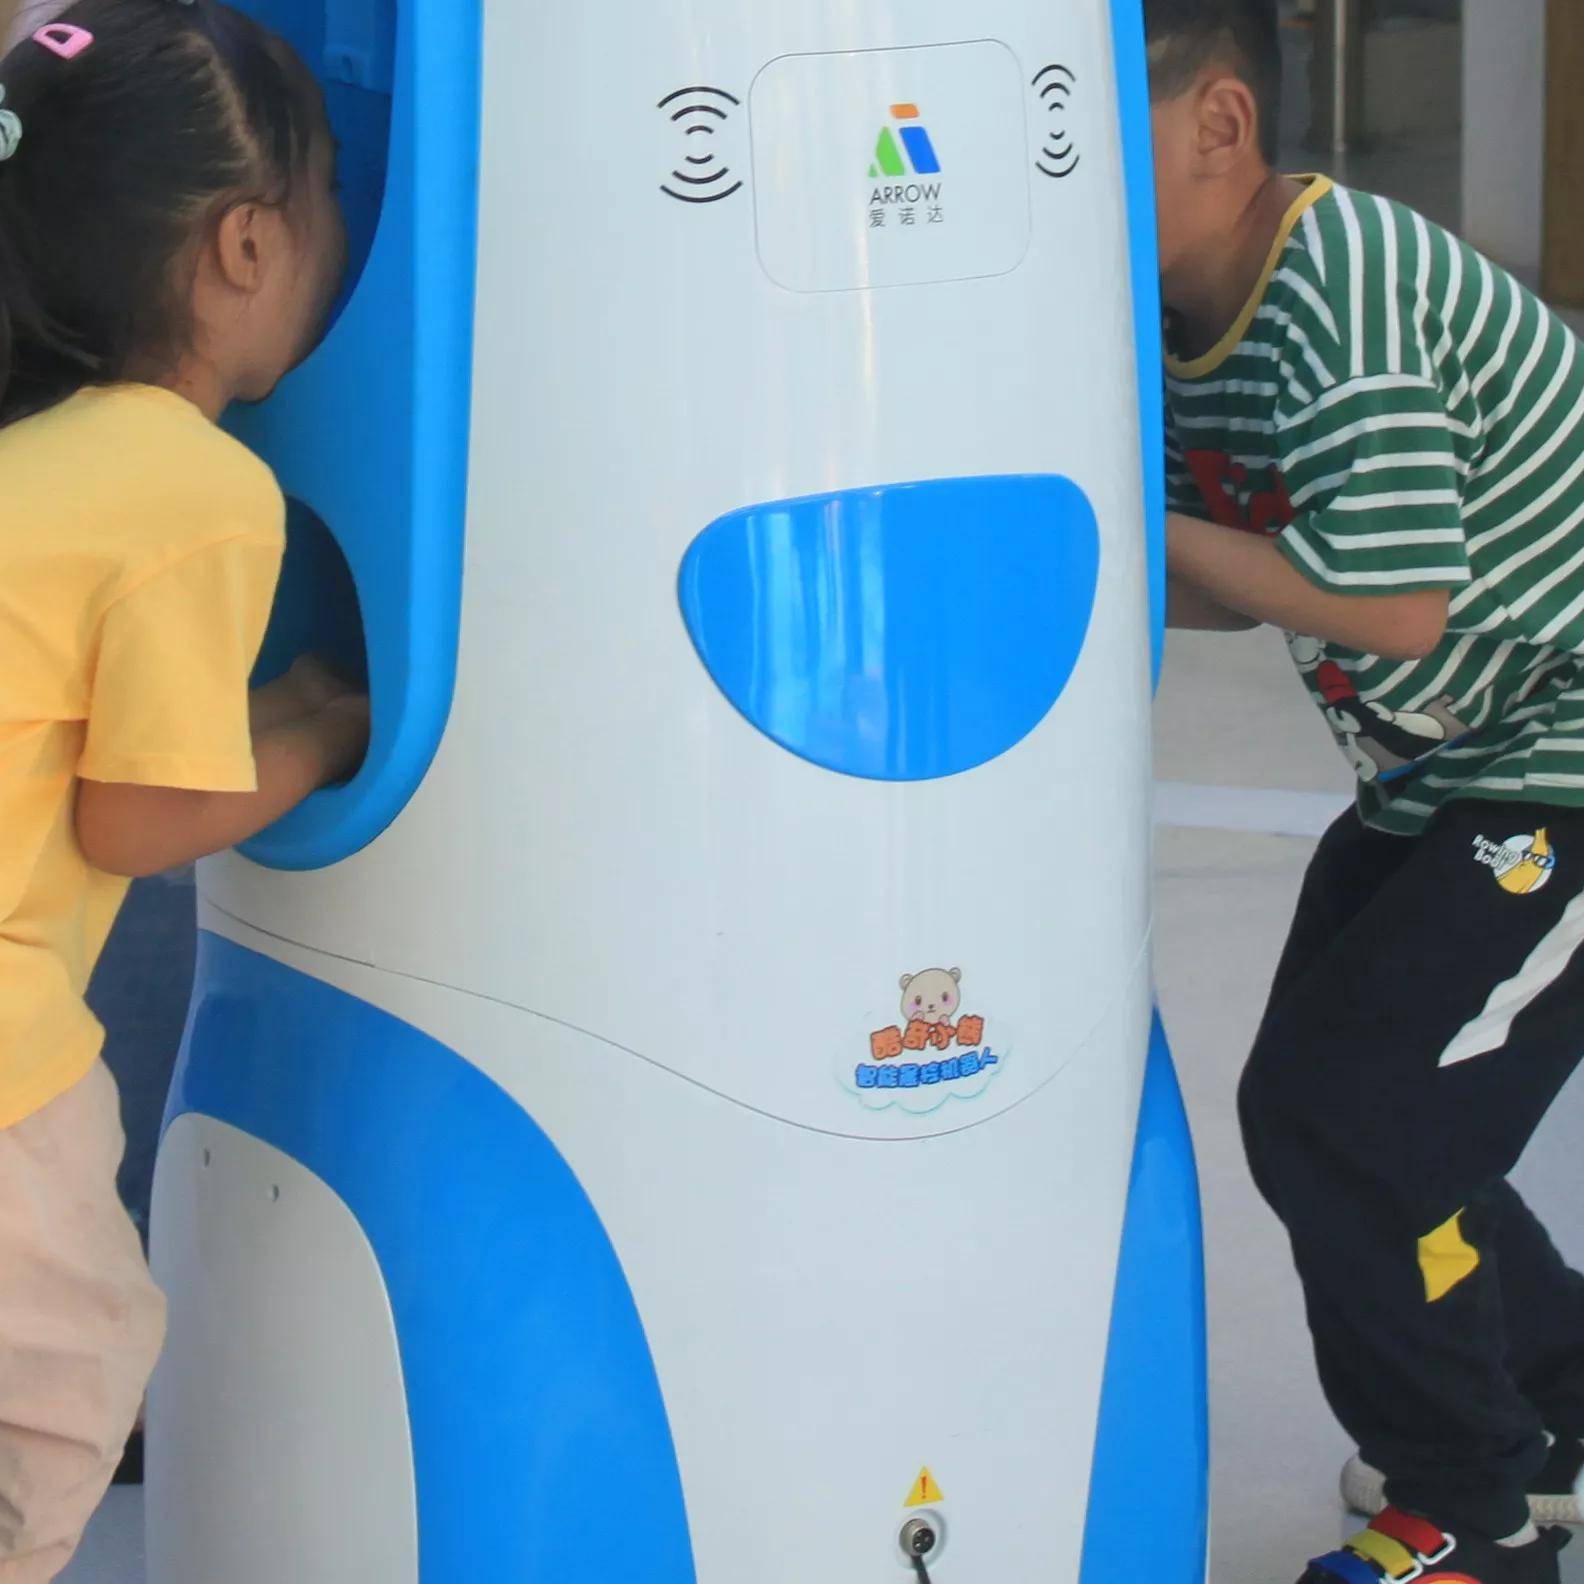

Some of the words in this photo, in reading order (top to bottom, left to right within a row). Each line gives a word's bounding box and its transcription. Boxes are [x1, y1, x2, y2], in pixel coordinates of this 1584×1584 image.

[869, 182, 943, 205] ARROW
[869, 204, 944, 228] 爱诺达
